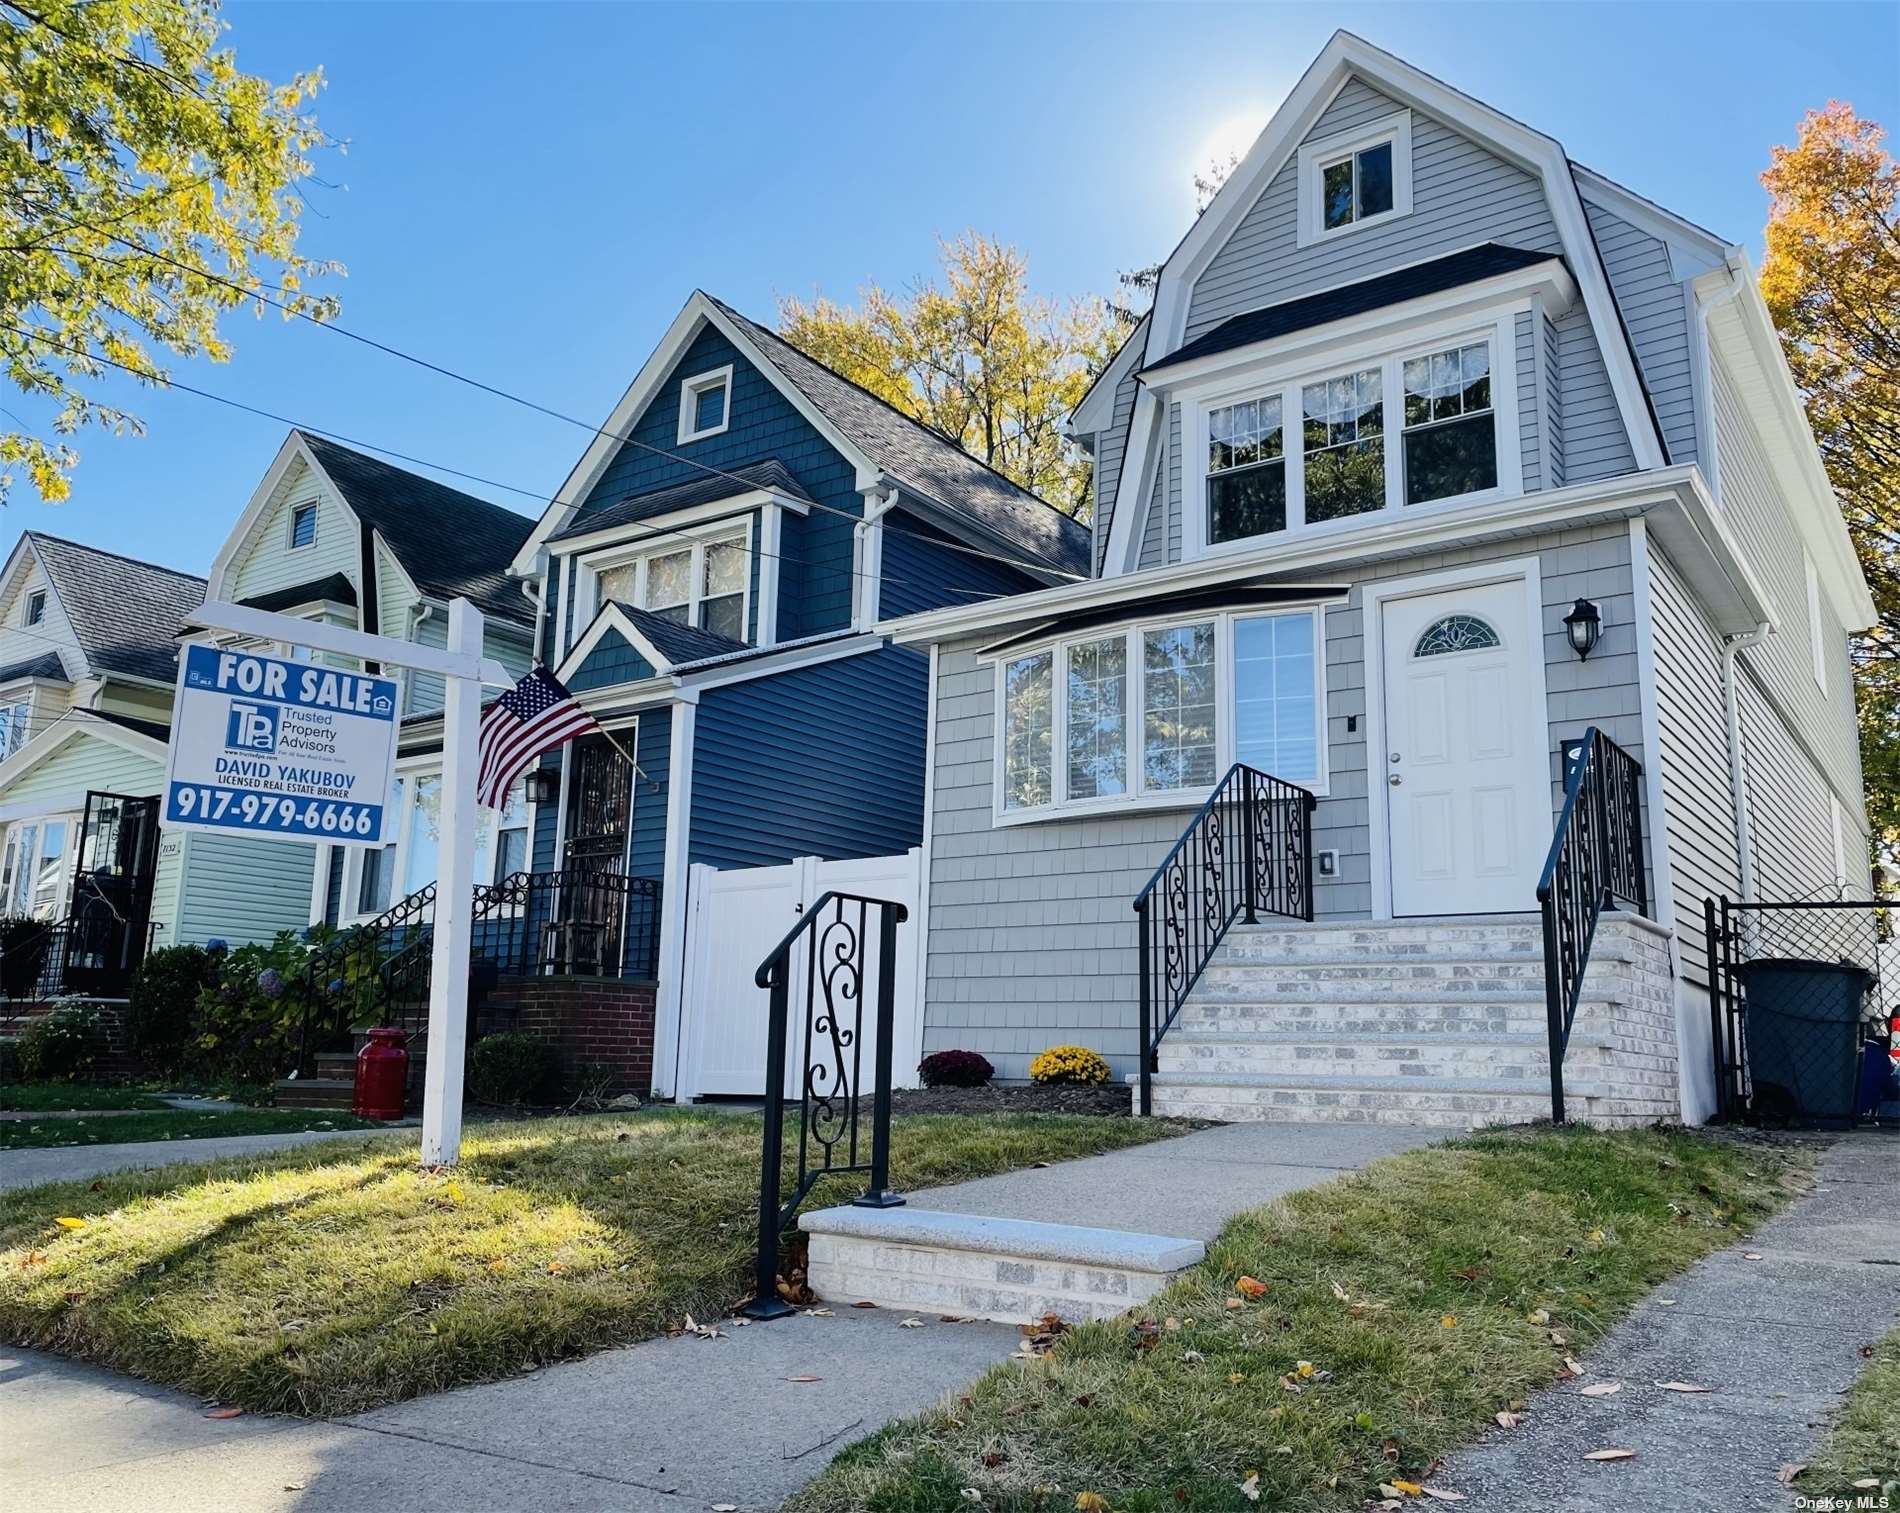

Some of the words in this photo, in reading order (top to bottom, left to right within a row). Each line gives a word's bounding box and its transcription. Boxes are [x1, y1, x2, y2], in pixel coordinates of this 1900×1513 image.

[217, 654, 287, 699] FOR
[300, 670, 374, 713] SALE
[284, 707, 332, 726] Trusted
[281, 721, 337, 742] Property
[279, 735, 336, 754] Advisors
[215, 757, 271, 778] DAVID
[278, 765, 356, 789] YAKUBOV
[218, 774, 261, 788] LICENSED
[263, 780, 285, 791] REAL
[287, 783, 316, 795] ESTATE
[317, 786, 350, 799] BROKER
[177, 787, 372, 834] 917-979-6666
